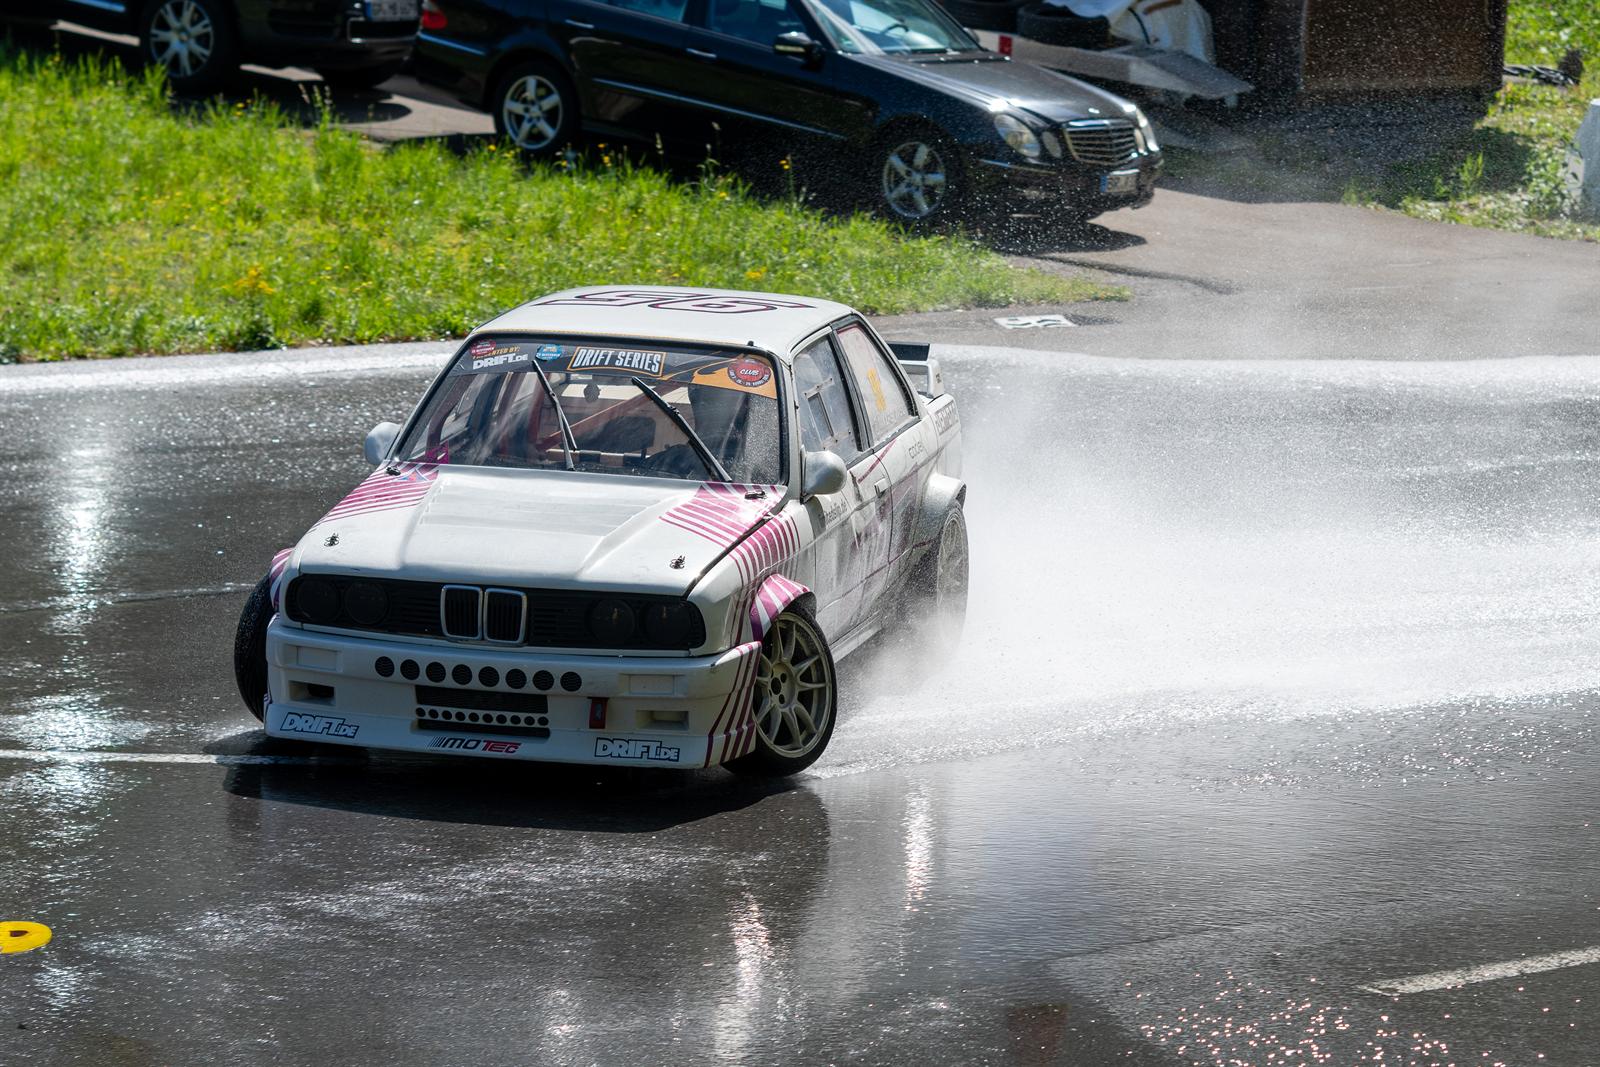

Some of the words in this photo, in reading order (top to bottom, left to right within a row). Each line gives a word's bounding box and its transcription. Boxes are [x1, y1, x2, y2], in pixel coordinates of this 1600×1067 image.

[472, 353, 529, 370] DRIFT.DE
[572, 348, 615, 368] DRIFT
[615, 351, 661, 373] SERIES
[280, 712, 360, 738] DRIFT.DE
[595, 737, 681, 762] DRIFT.DE
